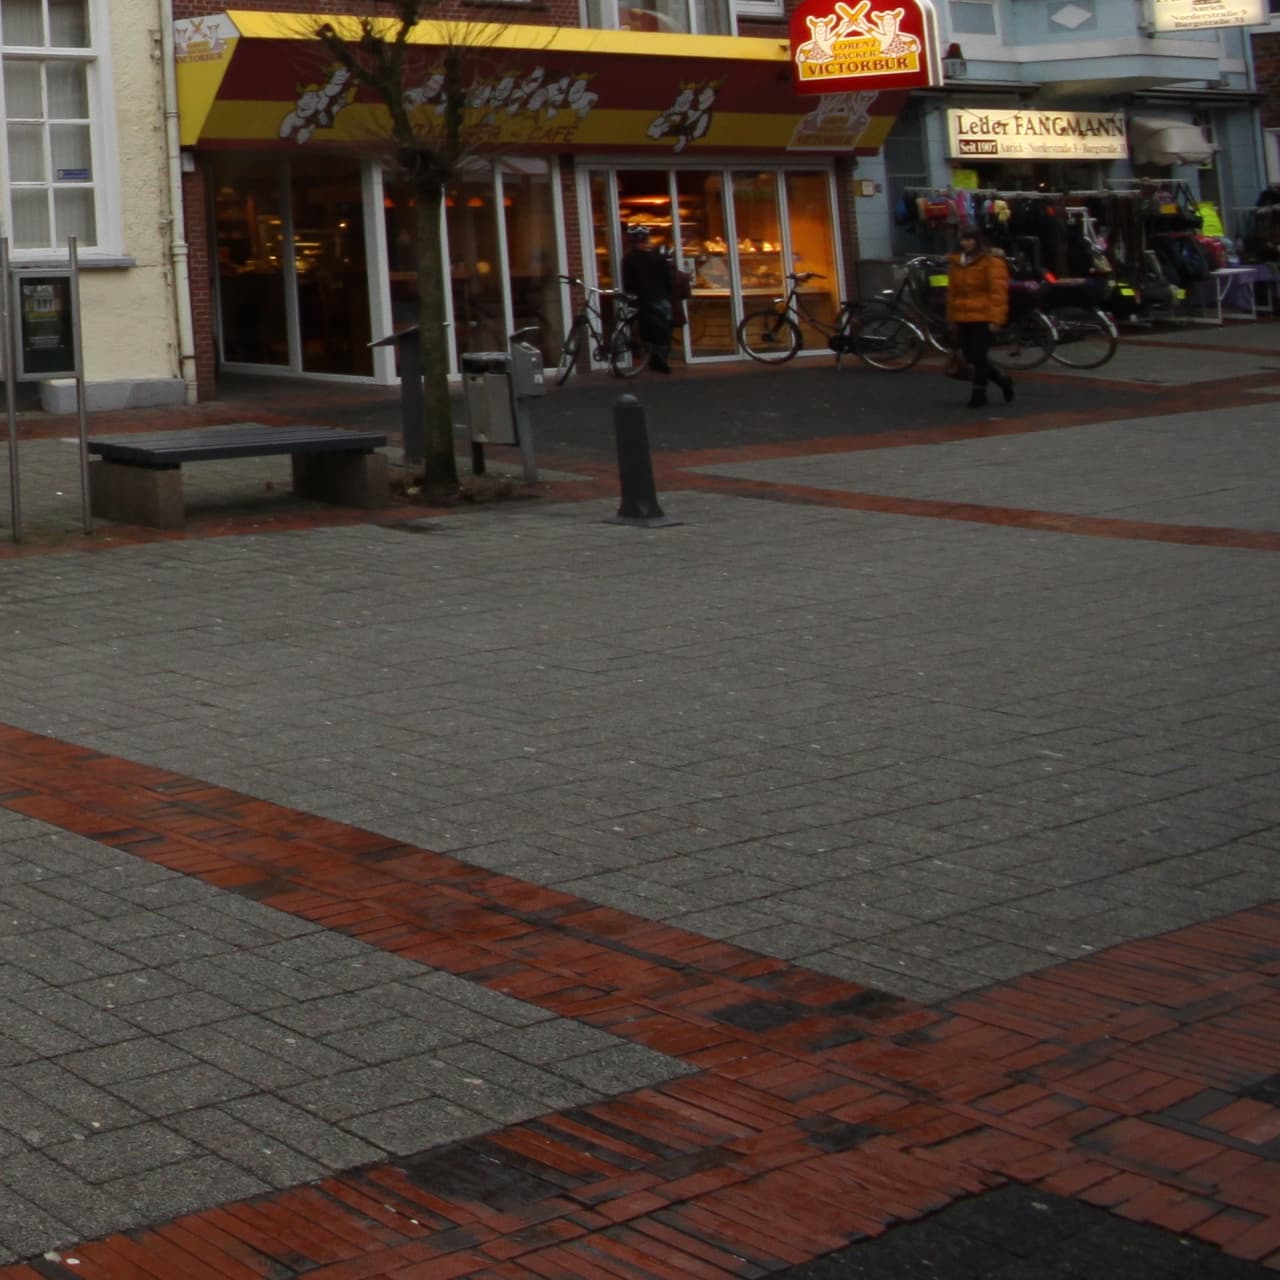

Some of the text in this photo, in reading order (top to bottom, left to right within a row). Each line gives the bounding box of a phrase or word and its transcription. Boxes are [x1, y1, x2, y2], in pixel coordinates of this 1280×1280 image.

[808, 57, 909, 77] VICTORBUR
[956, 114, 1125, 138] Leder FANGMANN
[960, 141, 977, 153] Seit
[977, 141, 997, 153] 1907
